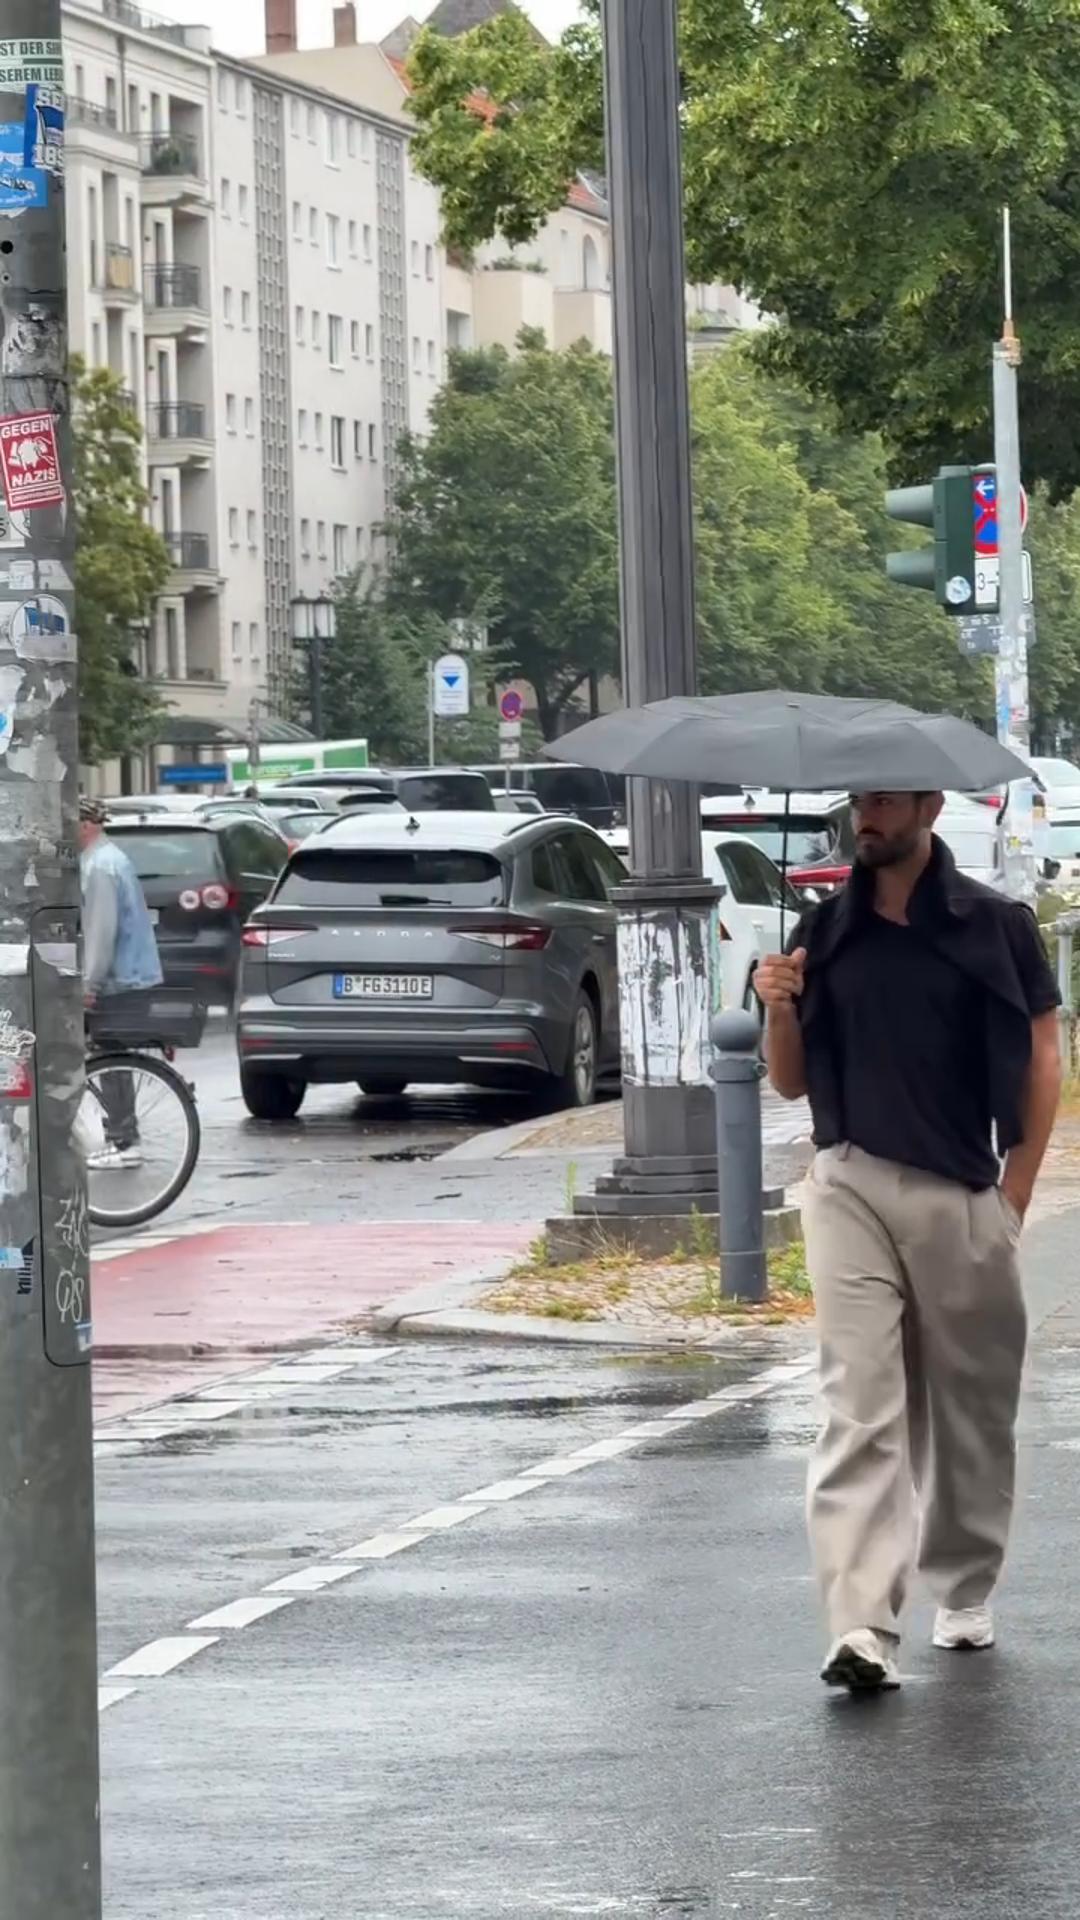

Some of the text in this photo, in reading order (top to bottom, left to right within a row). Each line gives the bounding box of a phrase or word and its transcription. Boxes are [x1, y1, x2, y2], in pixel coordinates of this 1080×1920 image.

[20, 42, 44, 55] DER
[1, 419, 49, 439] GEGEN
[11, 467, 56, 487] NAZIS
[344, 977, 353, 993] B
